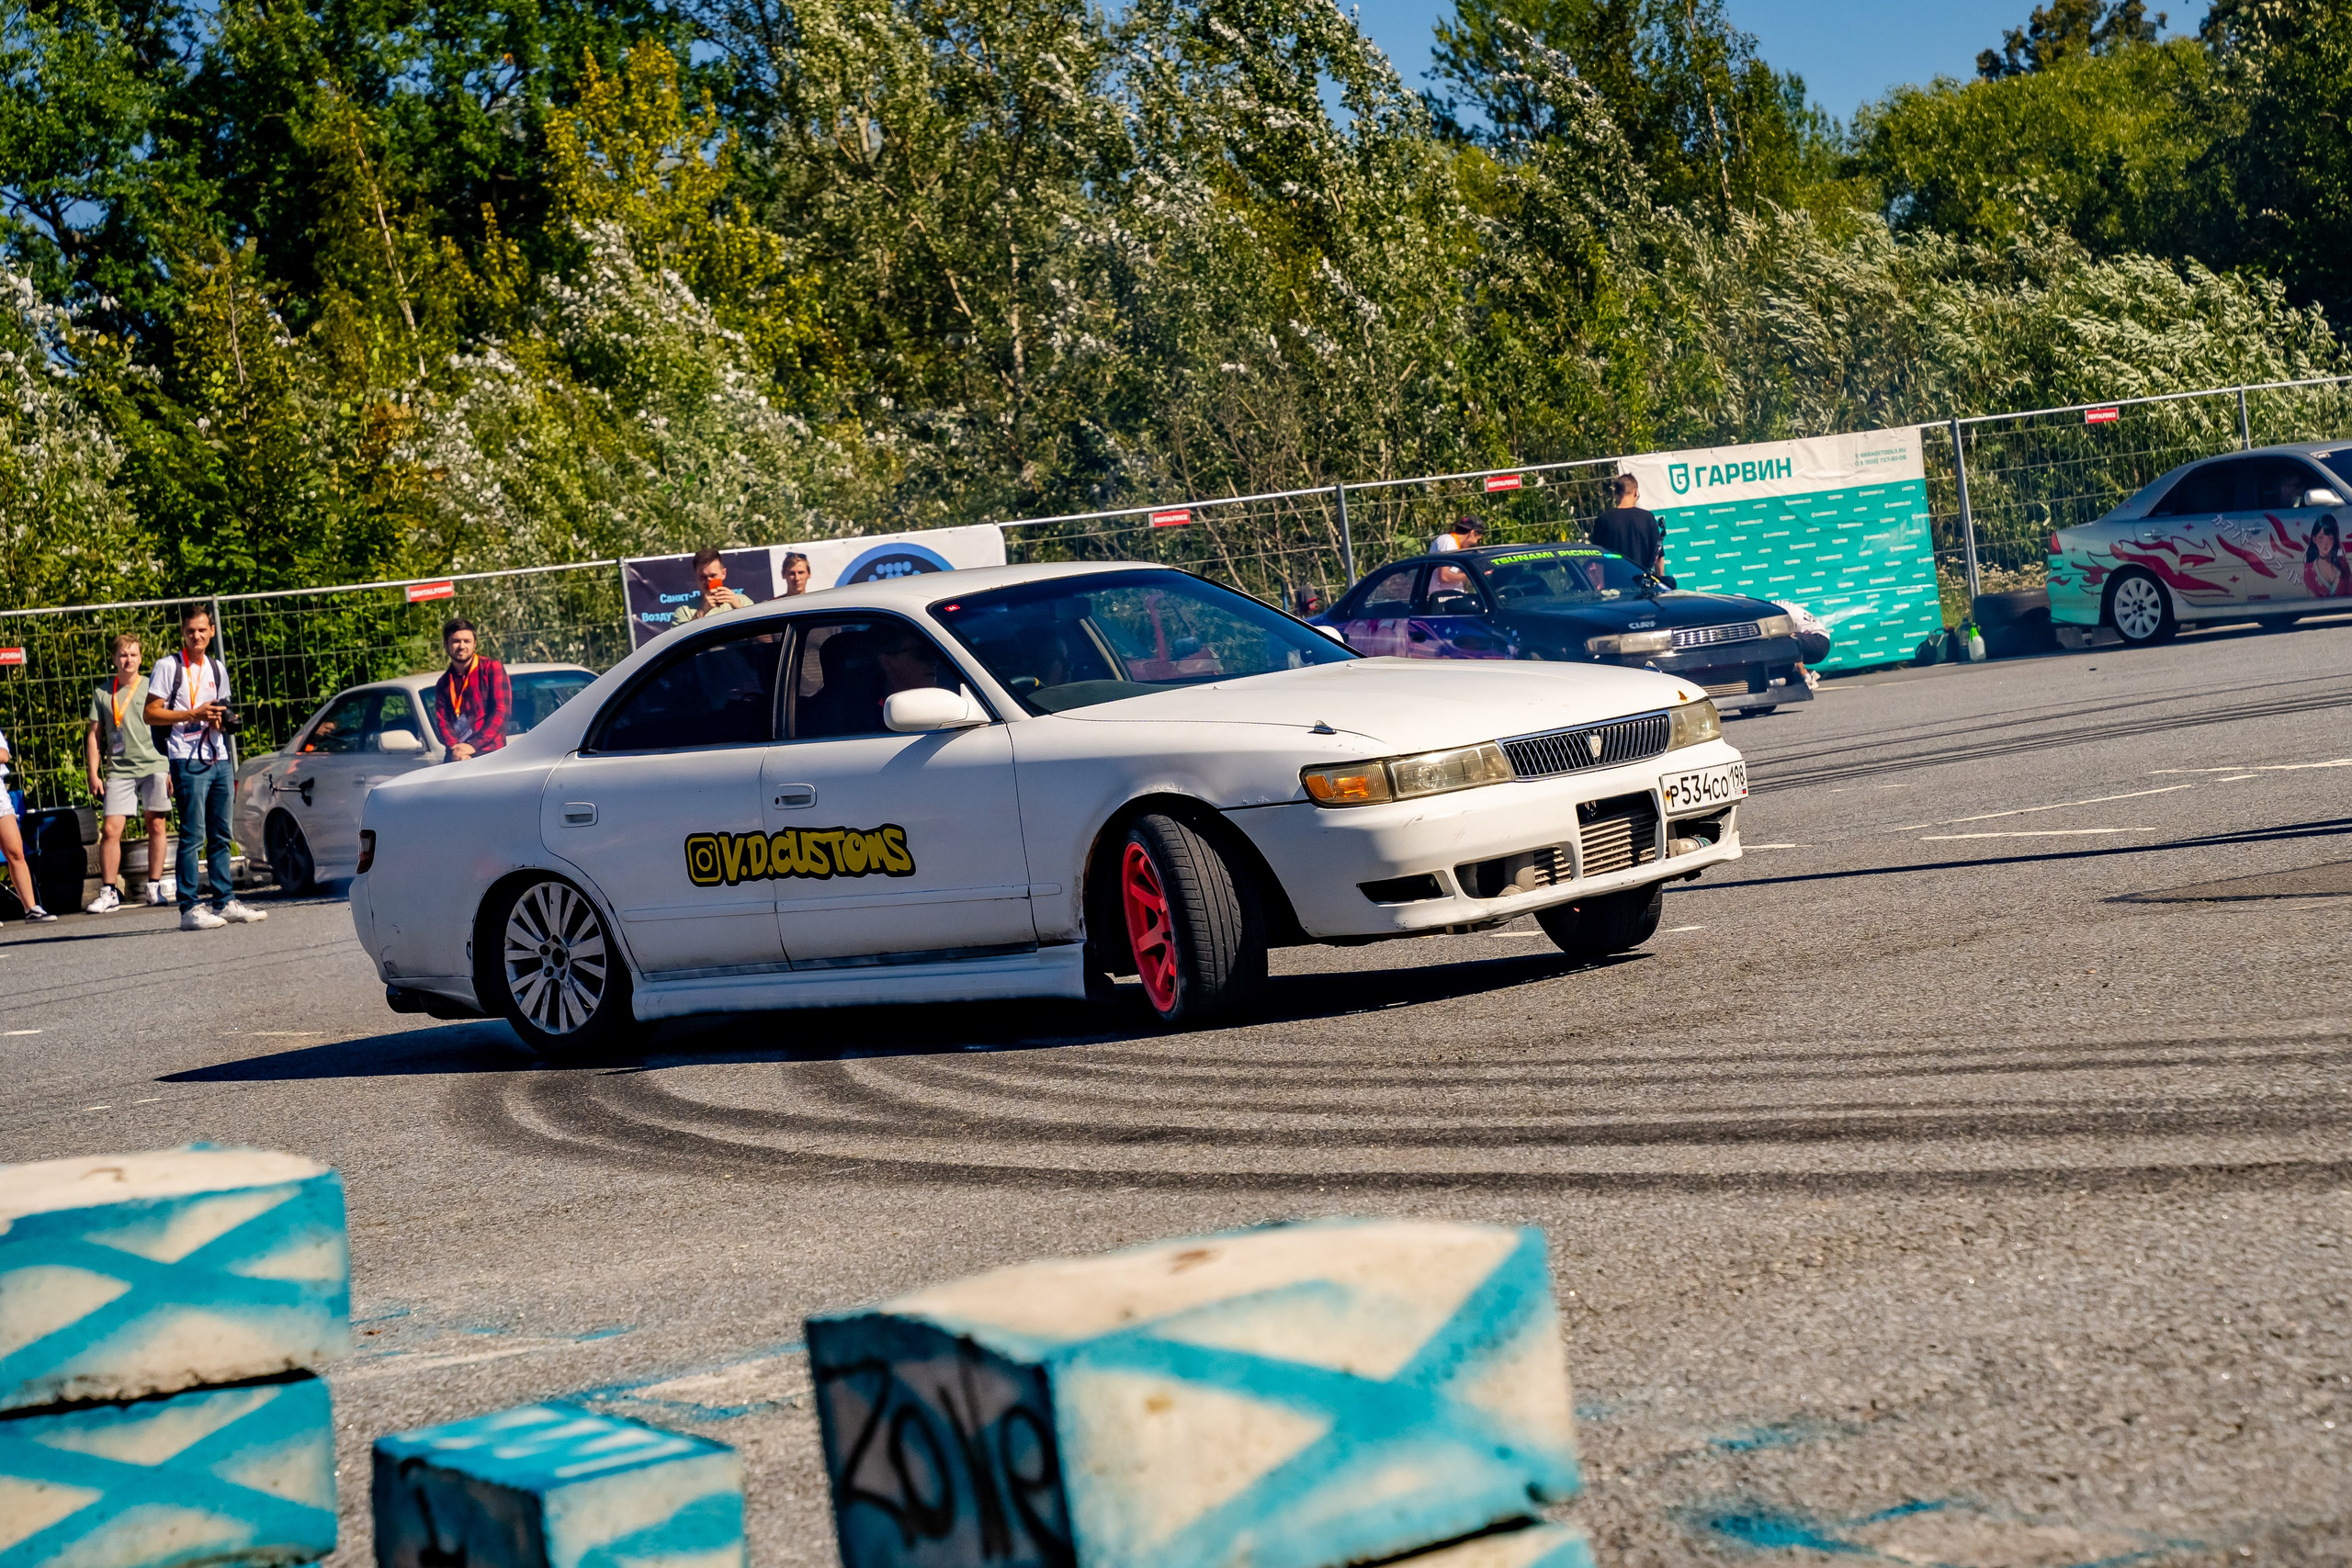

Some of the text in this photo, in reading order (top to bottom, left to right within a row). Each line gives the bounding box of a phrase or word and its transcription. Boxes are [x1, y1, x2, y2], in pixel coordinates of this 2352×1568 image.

[1695, 457, 1792, 488] ГАРВИН
[1490, 551, 1555, 566] TSUNAMI
[641, 611, 674, 622] Возду
[0, 651, 21, 660] FORM
[1730, 765, 1746, 787] 198
